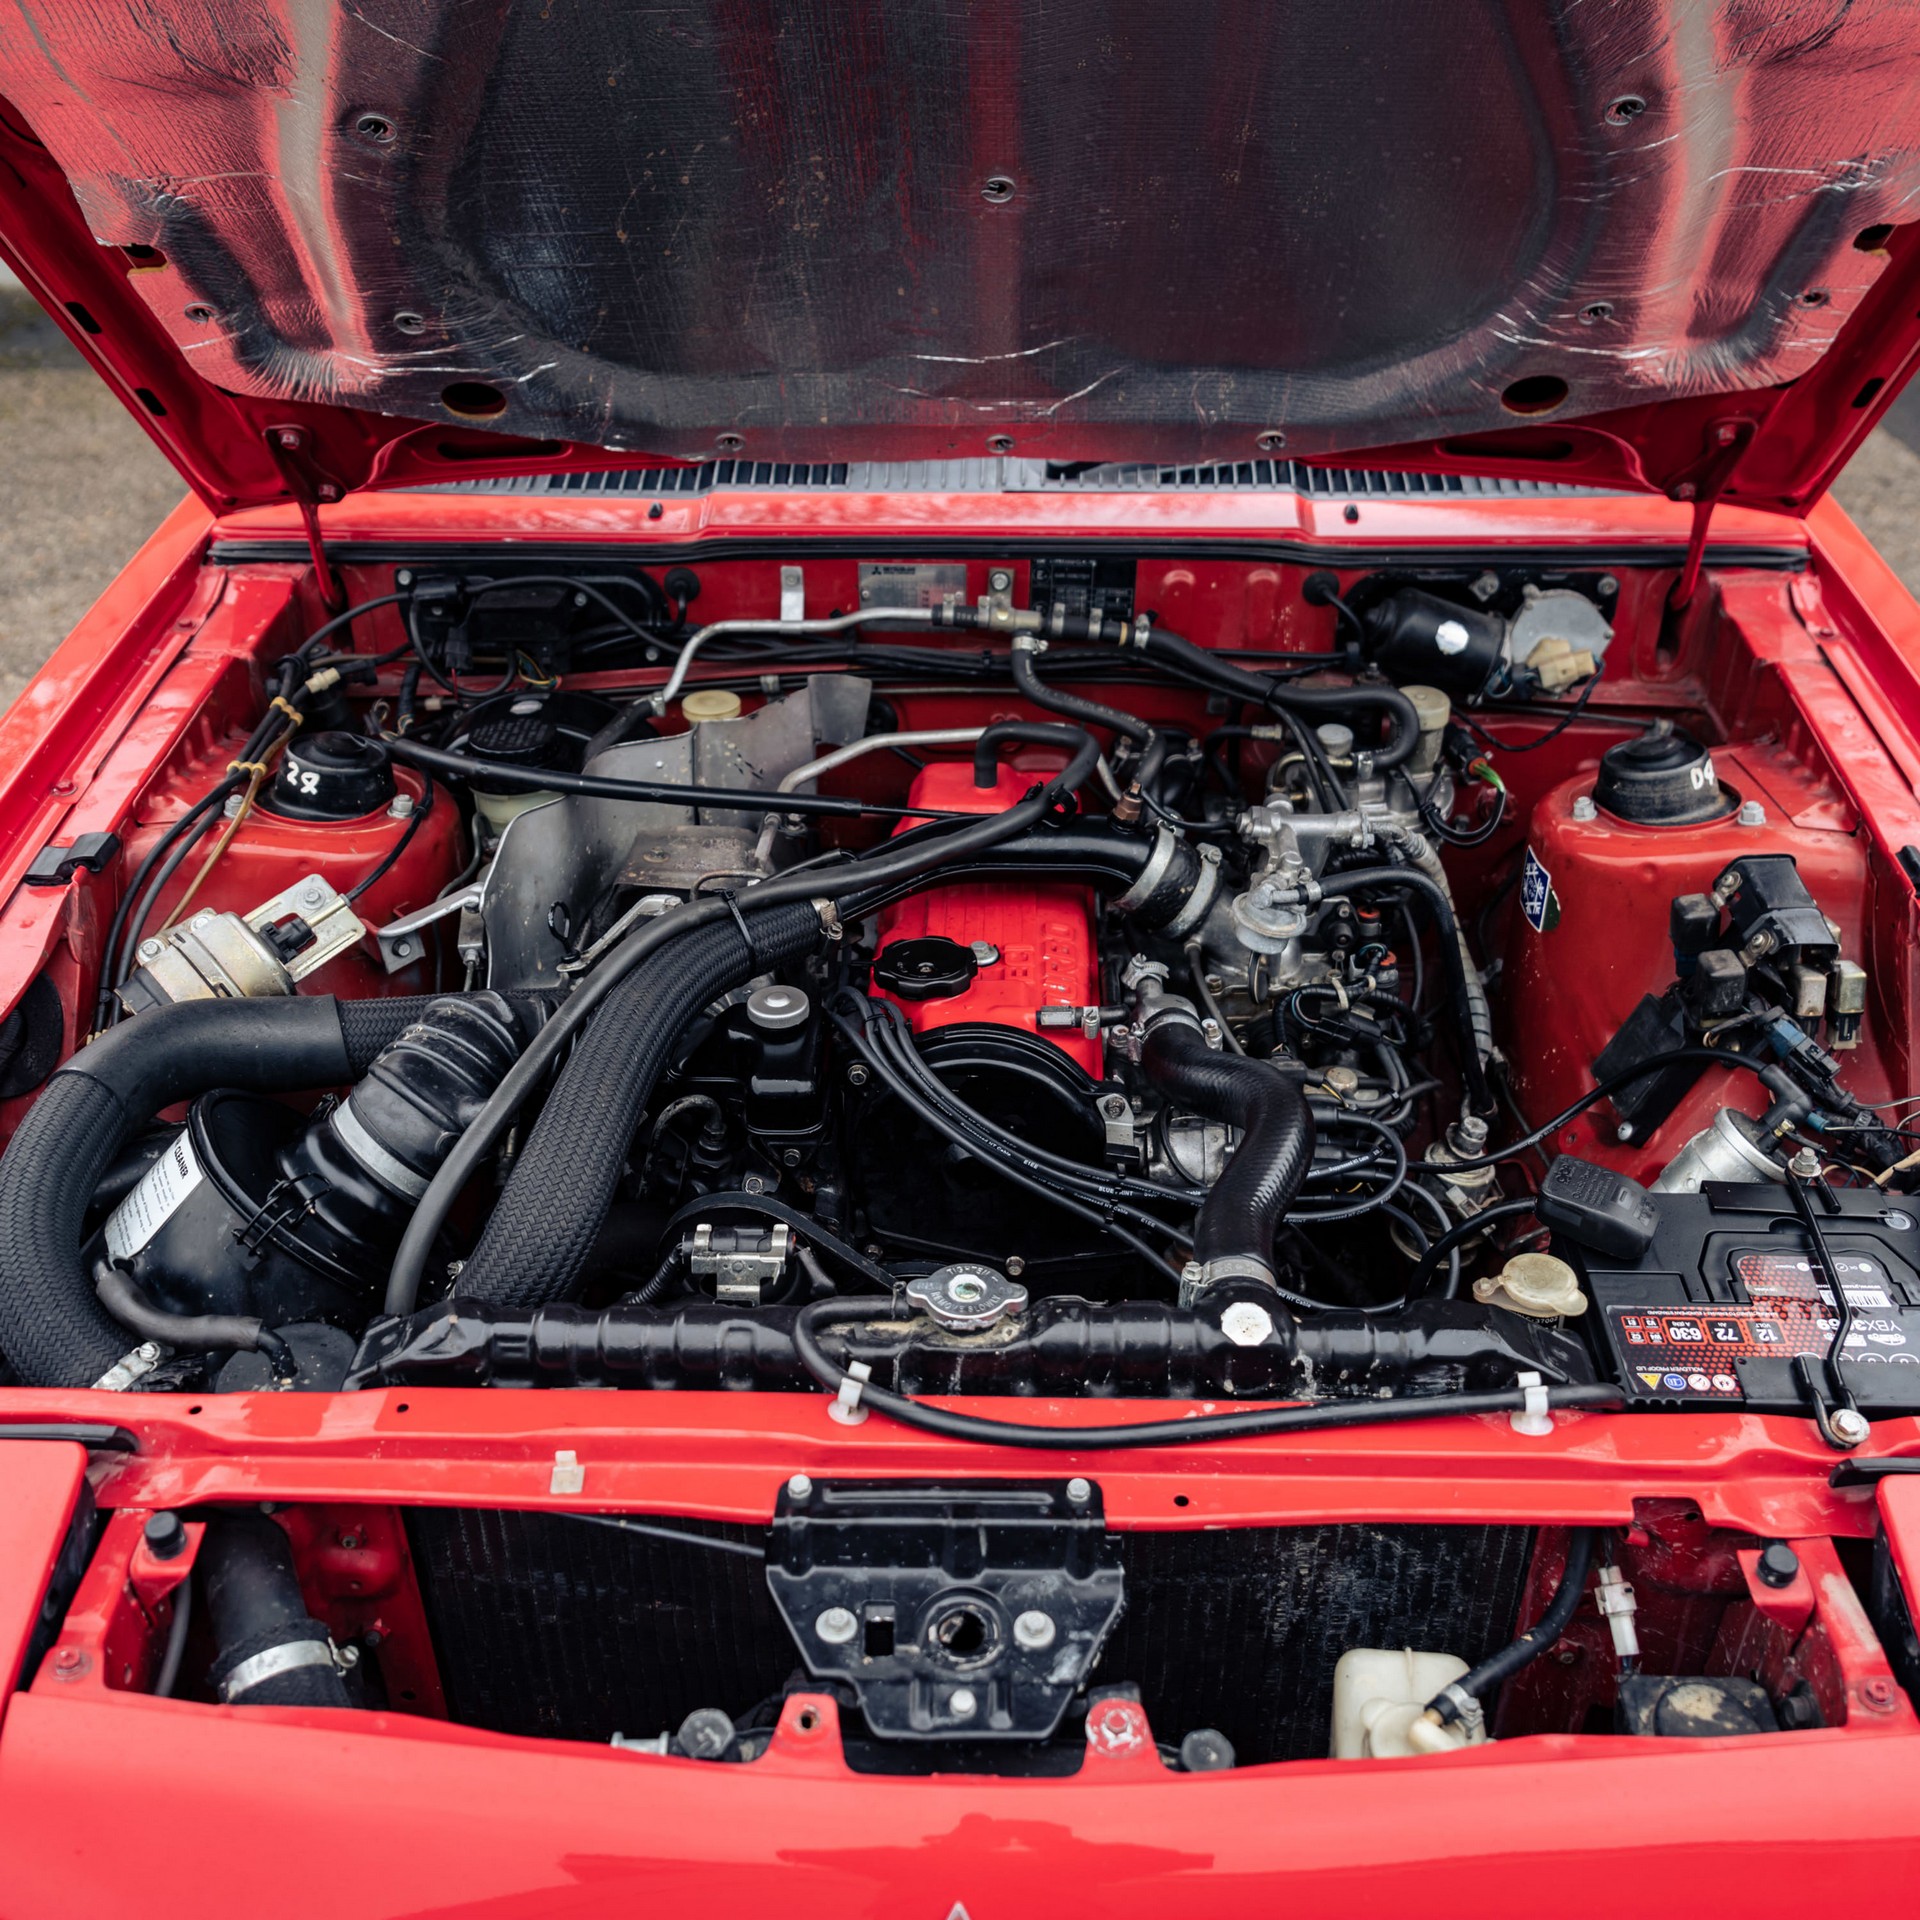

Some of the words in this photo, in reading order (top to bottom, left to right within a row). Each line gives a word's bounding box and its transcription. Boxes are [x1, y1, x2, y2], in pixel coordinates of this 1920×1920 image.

[174, 1146, 189, 1180] CLEANER
[1098, 1186, 1115, 1195] BLUE
[967, 1294, 1001, 1313] SLOWLY
[1669, 1327, 1702, 1340] 630
[1714, 1327, 1738, 1341] 72
[1755, 1328, 1778, 1341] 12
